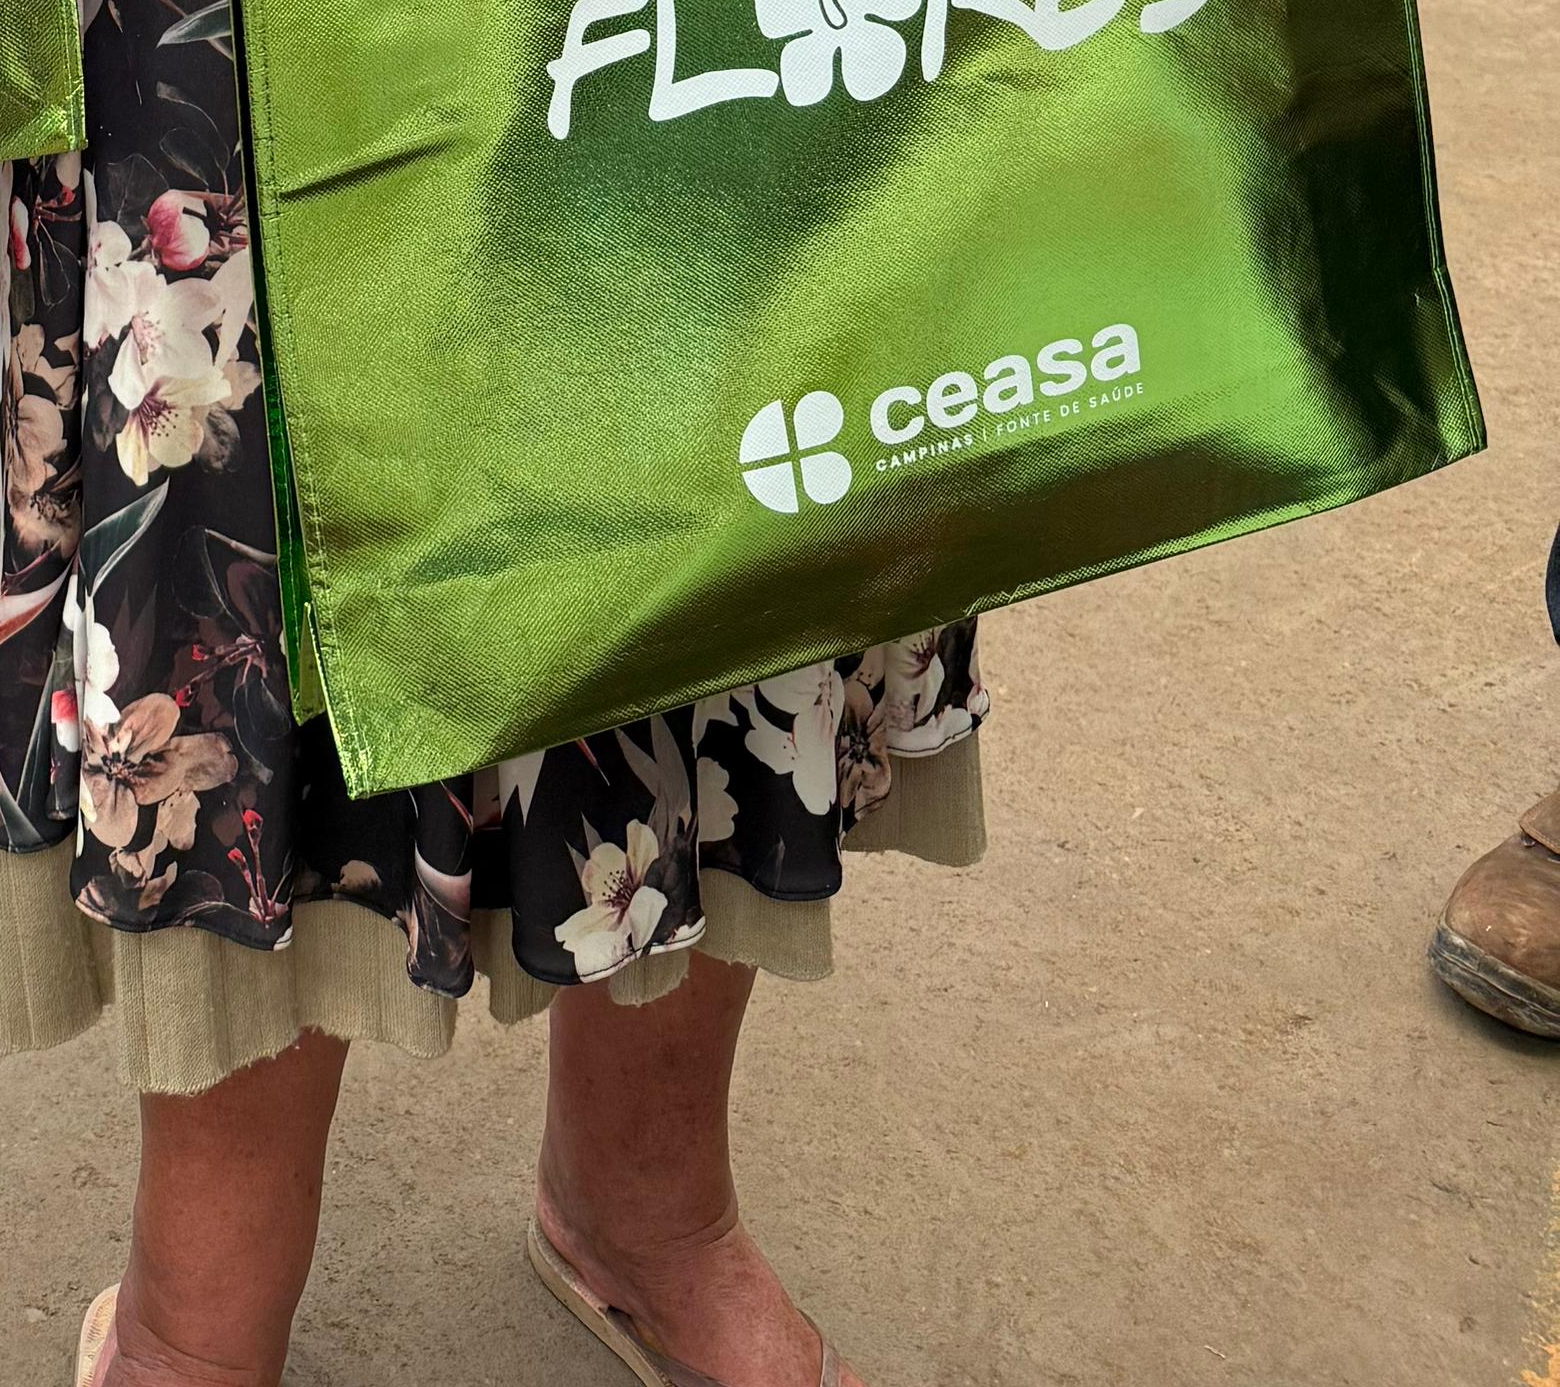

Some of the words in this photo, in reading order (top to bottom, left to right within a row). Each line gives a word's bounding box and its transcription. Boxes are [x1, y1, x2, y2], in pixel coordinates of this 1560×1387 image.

[869, 323, 1141, 445] ceasa
[875, 432, 975, 473] CAMPINAS
[995, 409, 1052, 438] FONTE
[1059, 401, 1081, 418] DE
[1088, 382, 1145, 408] SAÚDE
